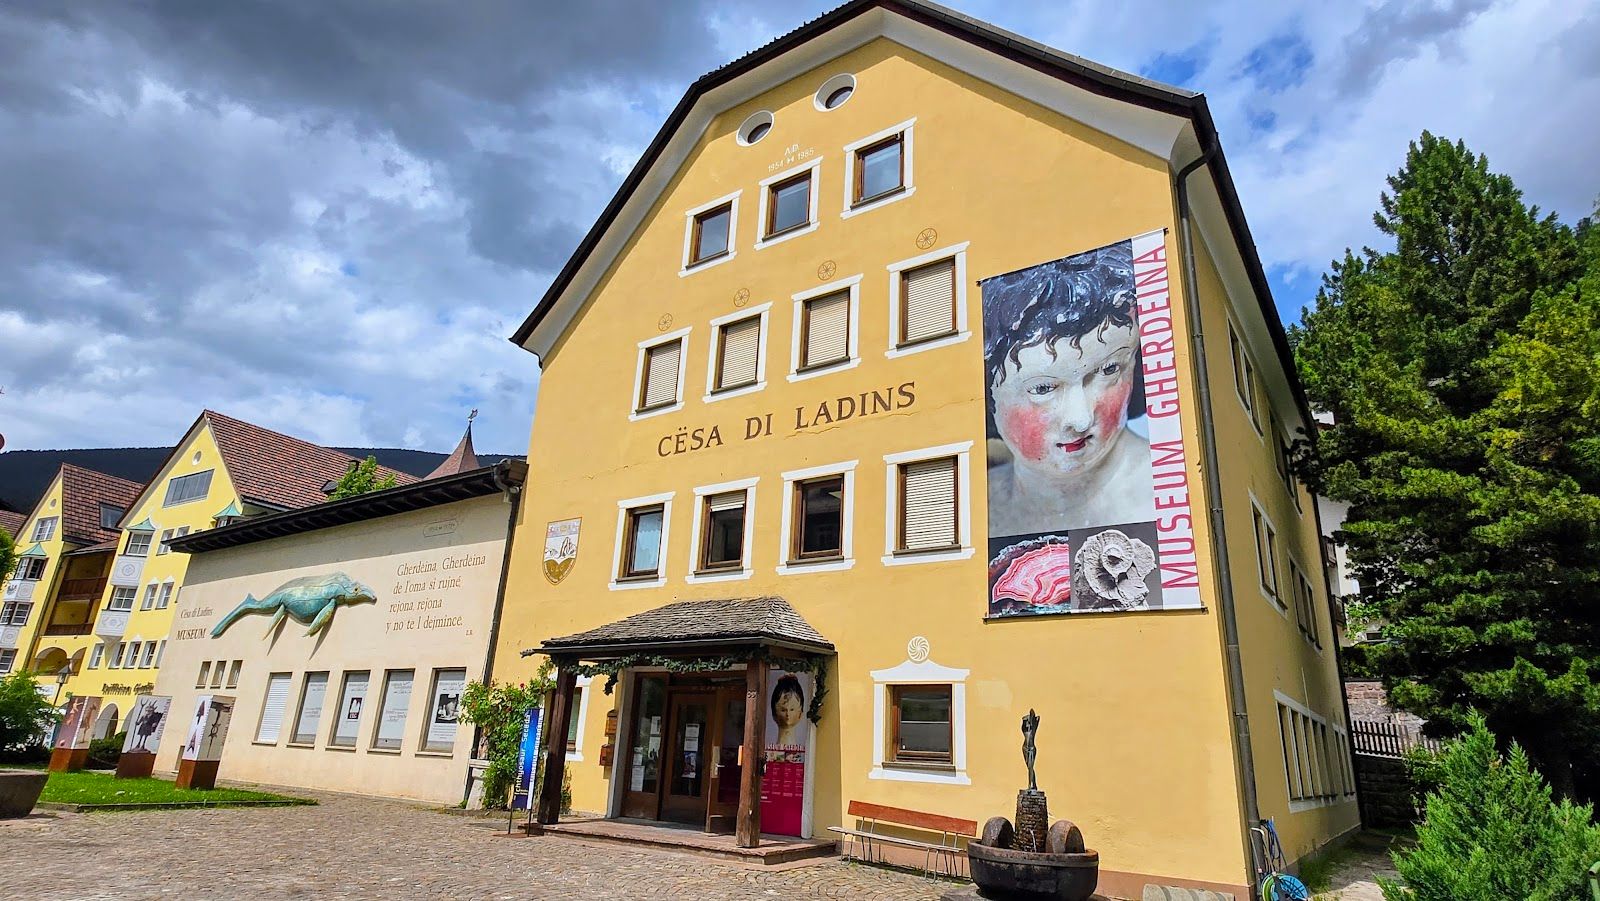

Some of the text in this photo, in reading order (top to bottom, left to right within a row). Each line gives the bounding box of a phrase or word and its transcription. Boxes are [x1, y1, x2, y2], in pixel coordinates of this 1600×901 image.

[657, 381, 916, 458] CËSA DI LADINS
[1133, 244, 1200, 590] MUSEUM GHERDEINA
[393, 582, 402, 594] de
[429, 577, 436, 590] si
[417, 597, 443, 612] rejona
[176, 628, 206, 640] MUSEUM
[385, 621, 392, 634] y
[393, 621, 404, 631] no
[406, 620, 414, 630] te
